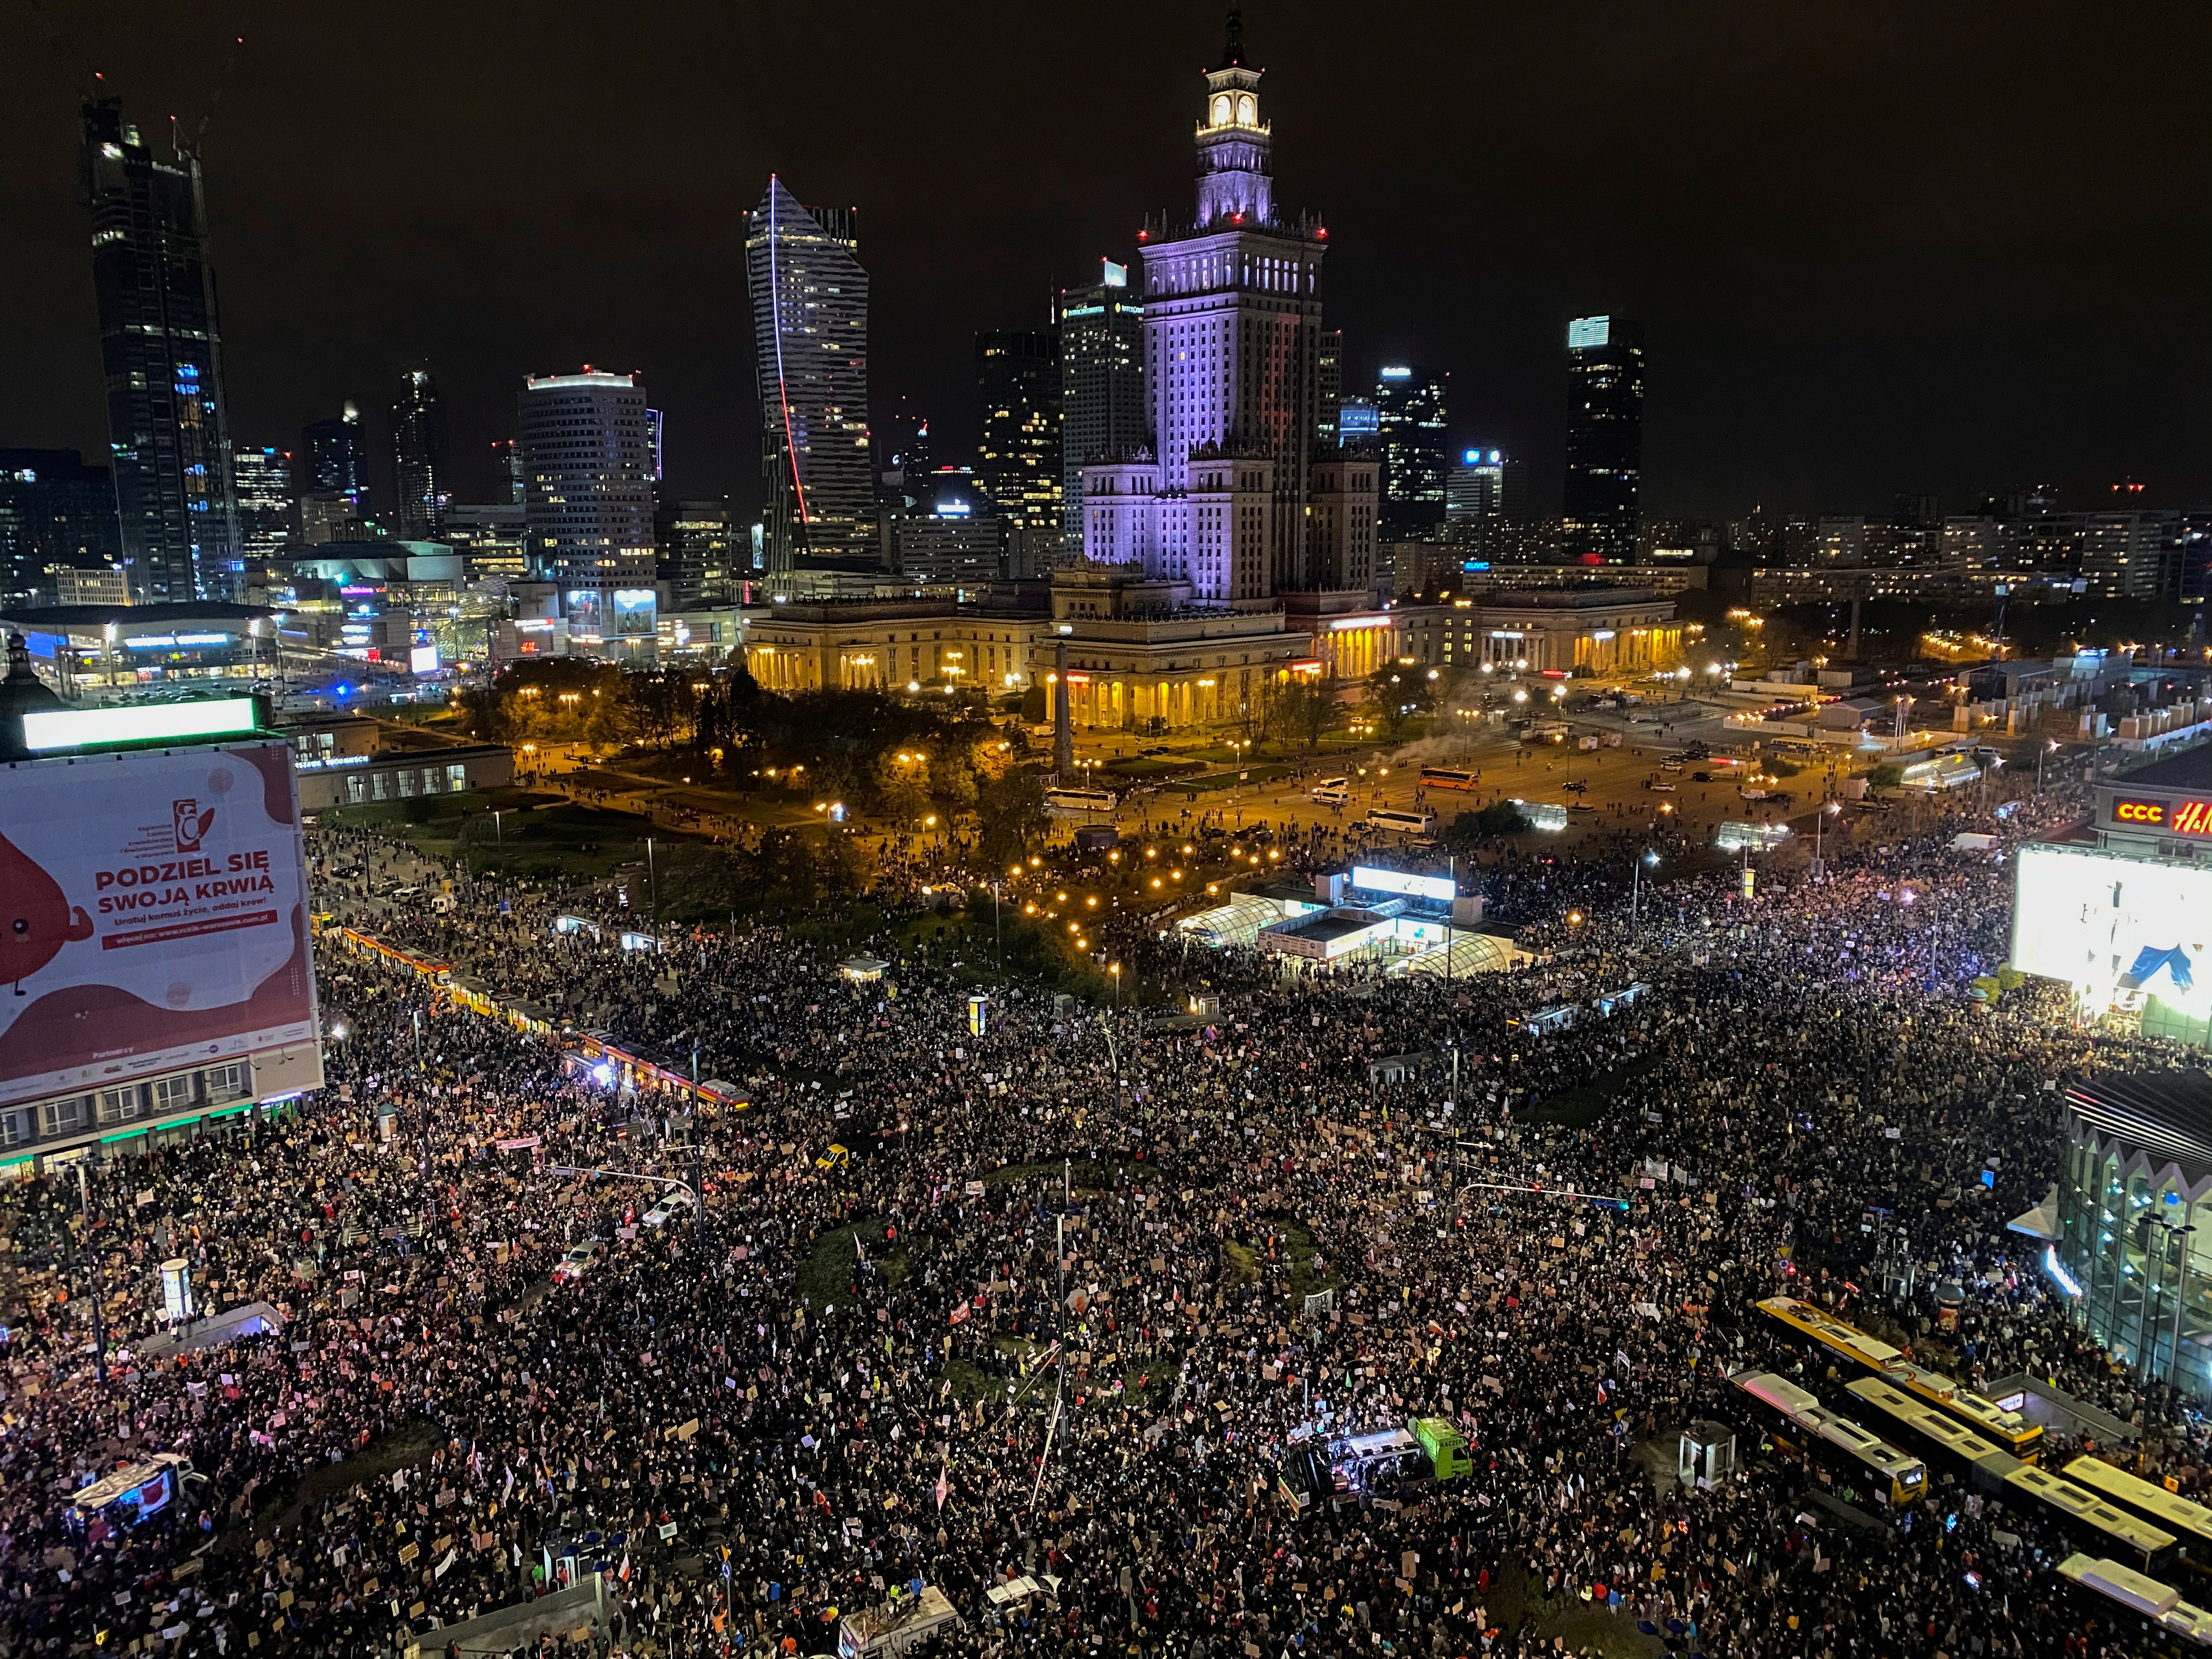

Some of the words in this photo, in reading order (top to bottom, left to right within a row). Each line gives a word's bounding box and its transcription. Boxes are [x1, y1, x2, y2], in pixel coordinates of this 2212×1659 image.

[2118, 803, 2163, 822] CCC
[95, 858, 221, 890] PODZIEL
[227, 850, 269, 873] SIĘ
[98, 887, 190, 913] SWOJĄ
[195, 875, 274, 899] KRWIĄ
[114, 912, 146, 926] Uratuj
[148, 910, 182, 922] komuś
[183, 906, 210, 917] życie,
[212, 900, 239, 911] oddaj
[240, 896, 267, 908] krew!
[92, 1046, 134, 1060] Partnerzy
